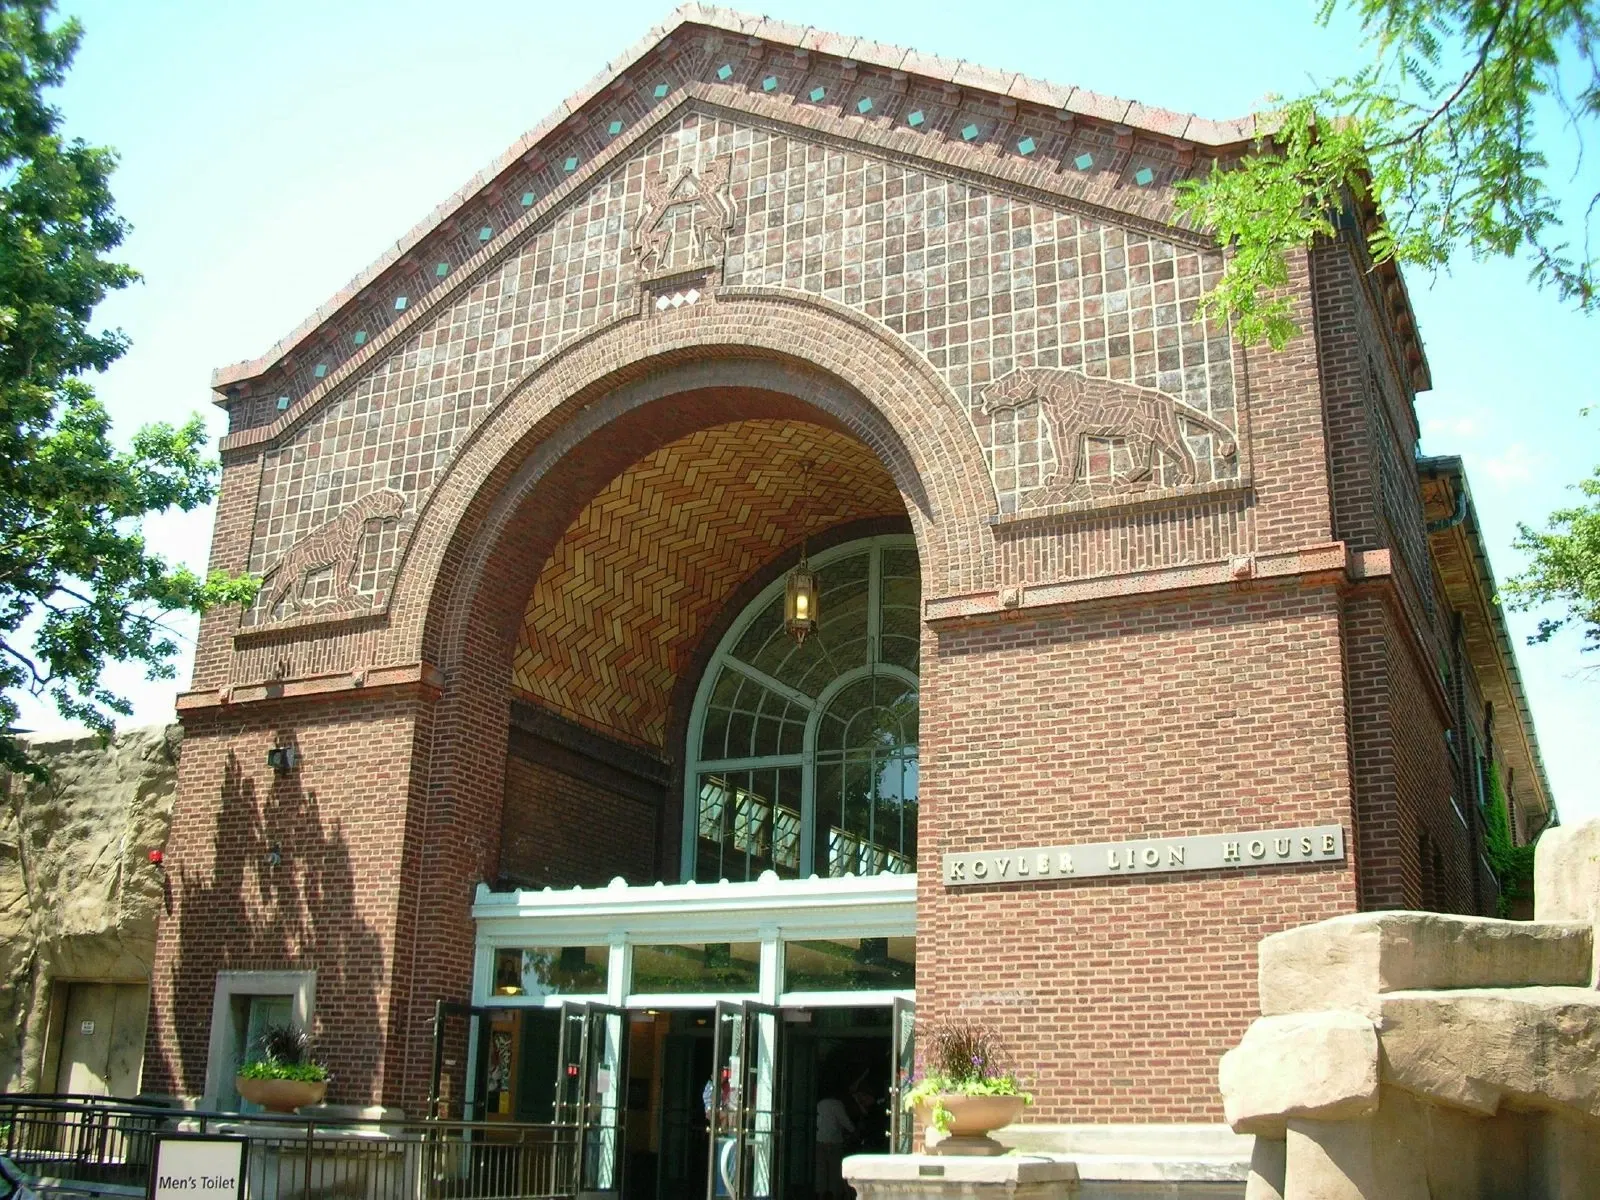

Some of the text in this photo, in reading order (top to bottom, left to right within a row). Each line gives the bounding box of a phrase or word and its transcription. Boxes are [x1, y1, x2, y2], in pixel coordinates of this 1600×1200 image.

[949, 833, 1336, 879] KOVLER LION HOUSE
[158, 1175, 235, 1190] Men's Toilet
